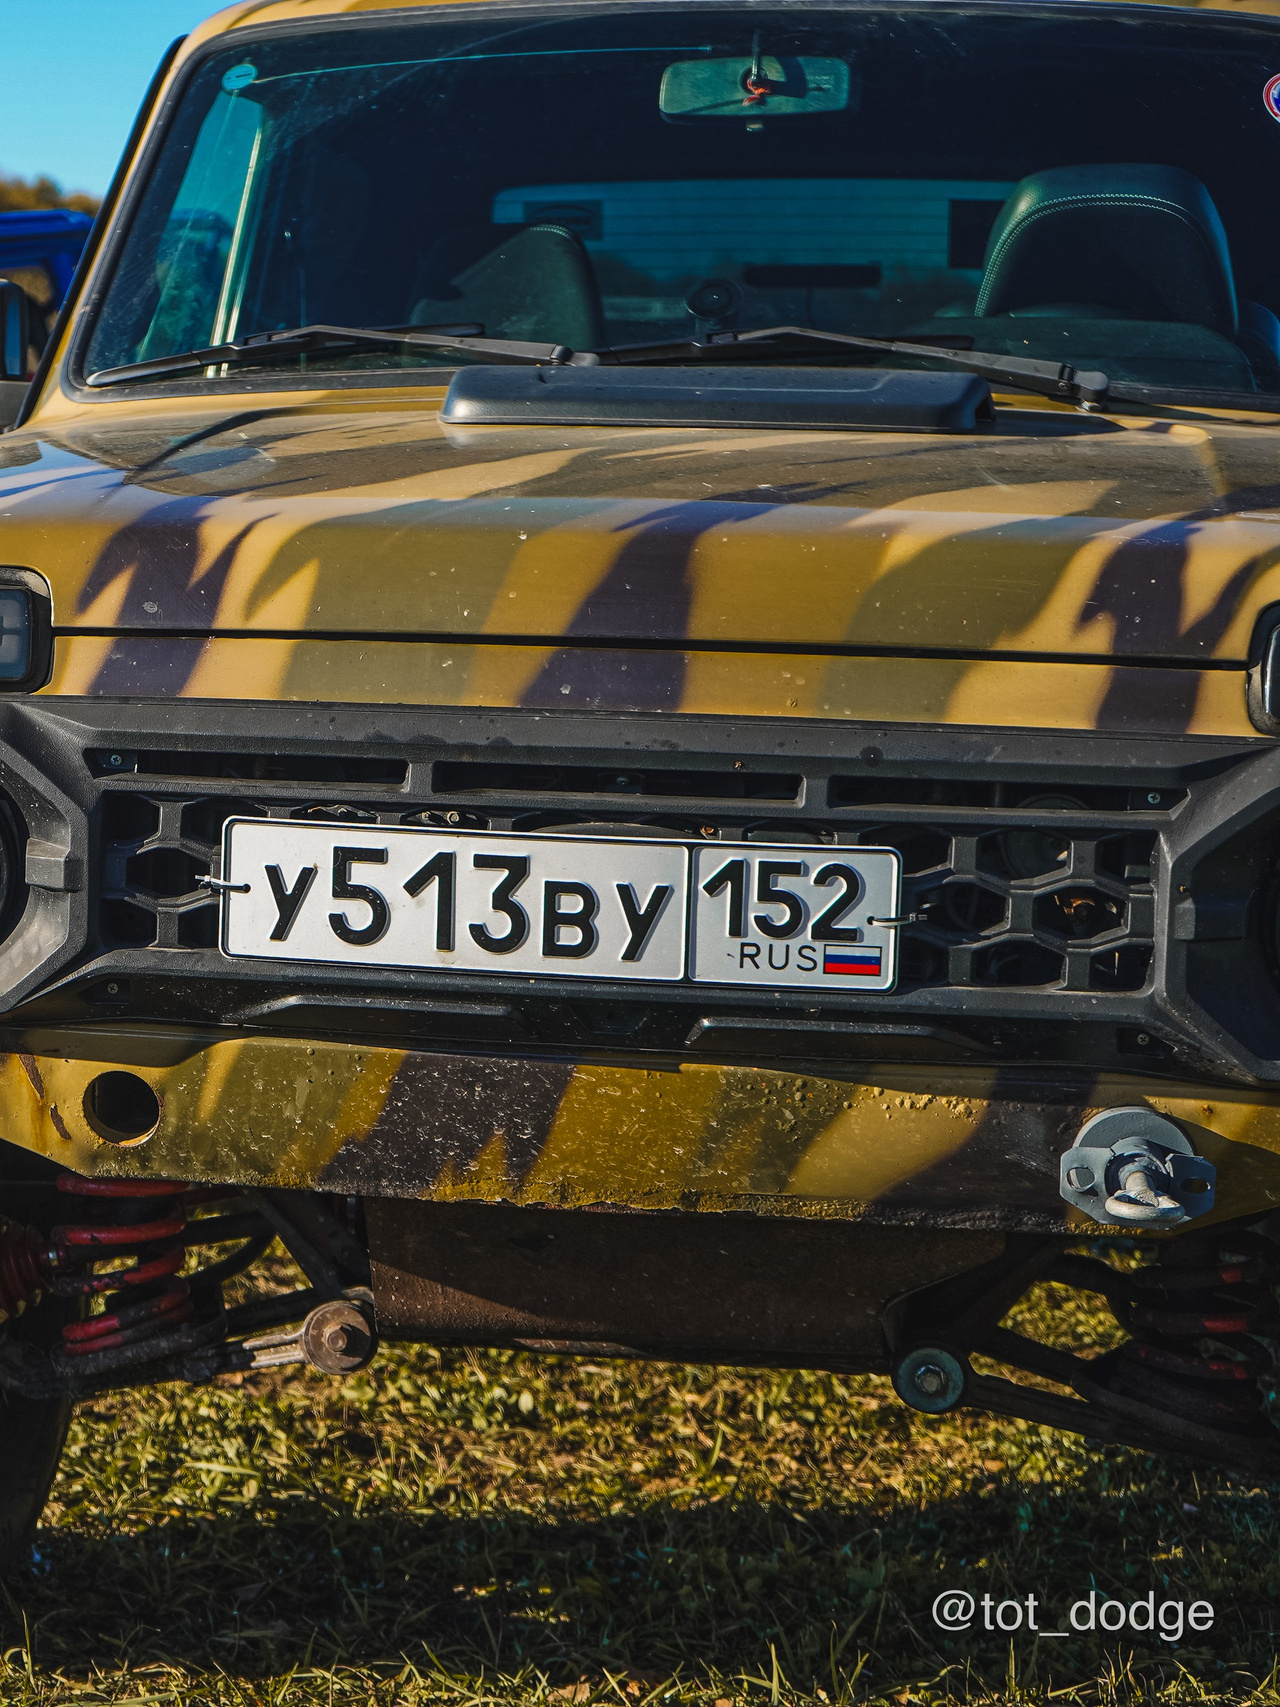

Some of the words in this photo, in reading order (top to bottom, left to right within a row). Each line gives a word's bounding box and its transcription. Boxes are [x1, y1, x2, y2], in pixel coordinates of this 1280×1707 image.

[263, 845, 672, 962] У513ВУ
[701, 858, 861, 943] 152
[738, 941, 819, 973] RUS
